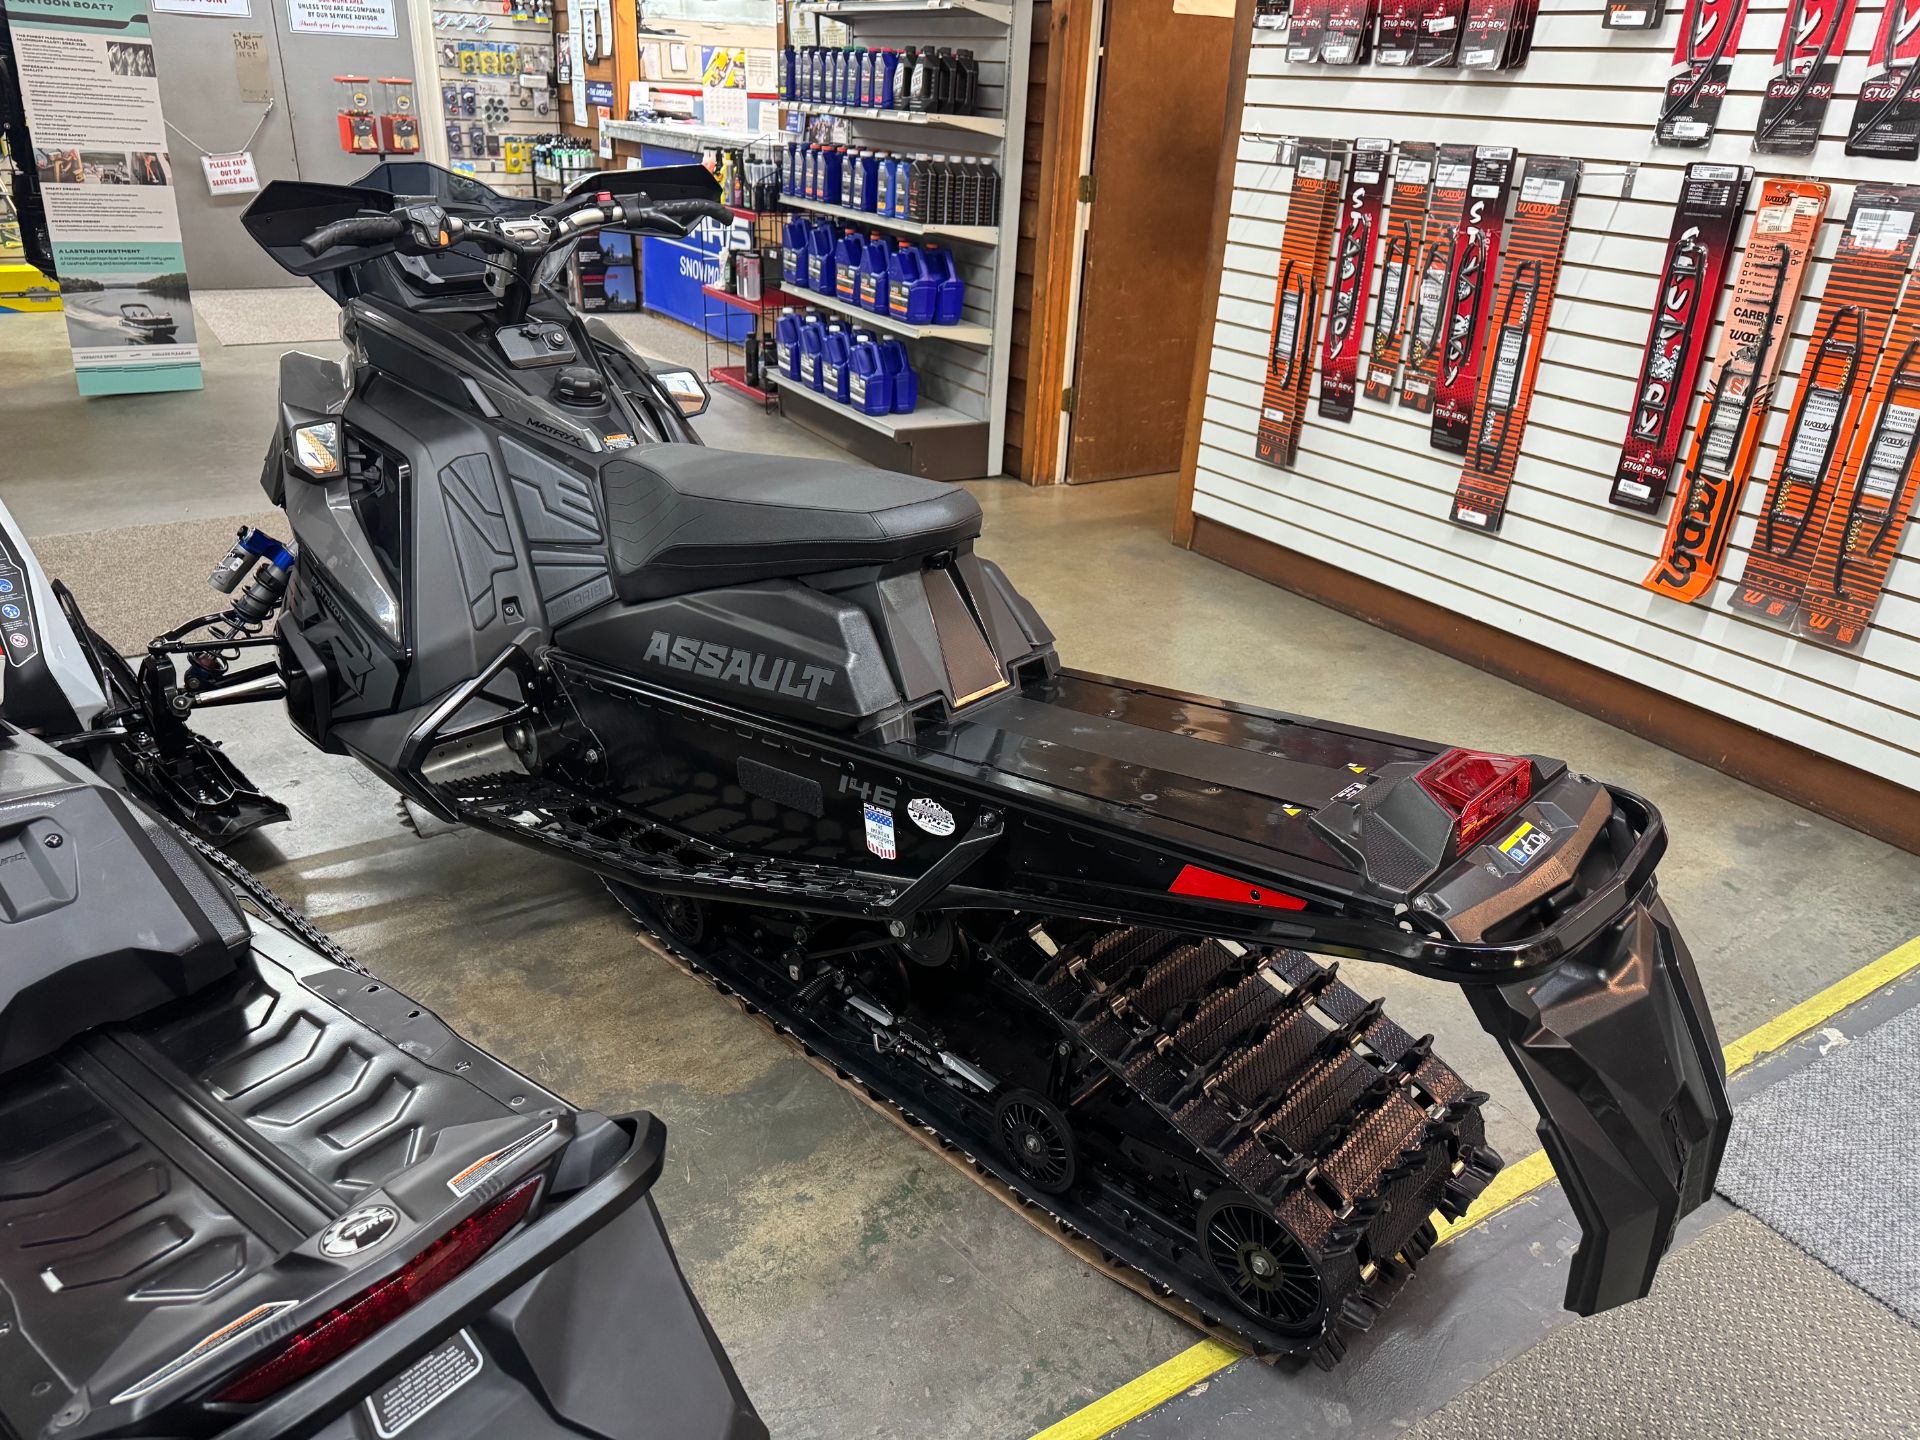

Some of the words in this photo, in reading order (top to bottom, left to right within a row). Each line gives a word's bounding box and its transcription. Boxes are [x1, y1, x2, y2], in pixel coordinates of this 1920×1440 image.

[73, 1, 114, 11] BOAT?
[298, 2, 320, 10] UNLESS
[346, 6, 385, 14] ACCOMPANIED
[1292, 20, 1305, 28] STUD
[1329, 20, 1343, 28] STUD
[1384, 20, 1399, 28] STUD
[1400, 20, 1415, 28] BOY
[1469, 20, 1486, 29] STUD
[1488, 20, 1504, 30] BOY
[234, 40, 258, 50] PUSH
[1671, 84, 1691, 95] STU
[1700, 85, 1726, 96] BOY
[1771, 84, 1798, 96] STUD
[1864, 87, 1896, 100] STUD
[212, 178, 237, 186] SERVICE
[238, 176, 254, 184] AREA
[1734, 308, 1784, 325] CARBE
[1452, 412, 1466, 422] BOY
[1892, 409, 1914, 417] RUNNER
[1886, 420, 1915, 429] STRUCTION
[1888, 415, 1916, 423] STALLATIO
[526, 418, 582, 446] MATRYX
[1623, 461, 1642, 471] STUD
[1644, 465, 1664, 476] BOY
[311, 578, 346, 622] PATRIOT
[642, 630, 837, 701] ASSAULT
[838, 775, 898, 809] 146
[864, 802, 892, 816] POLARIS
[397, 1378, 411, 1388] track
[413, 1380, 428, 1391] track
[426, 1372, 438, 1381] with
